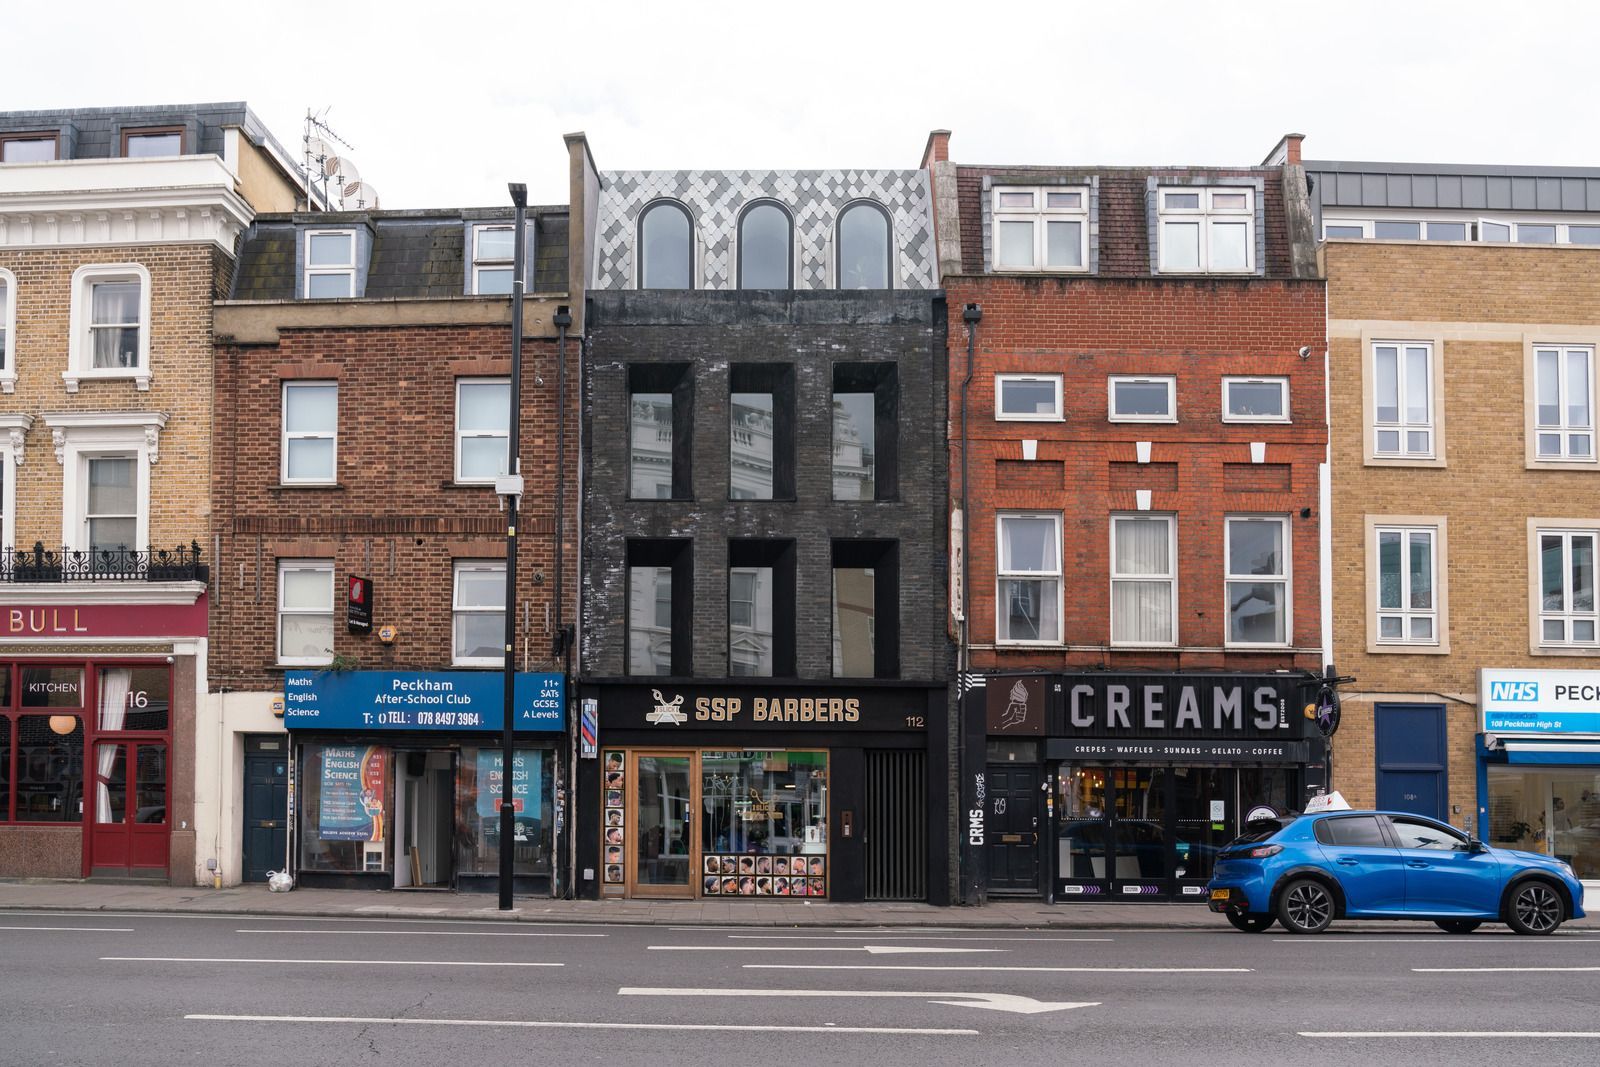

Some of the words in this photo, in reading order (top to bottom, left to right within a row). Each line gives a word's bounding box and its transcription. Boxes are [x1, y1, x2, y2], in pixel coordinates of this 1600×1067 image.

[9, 609, 88, 632] BULL
[288, 678, 313, 686] Maths
[392, 679, 453, 691] Peckham
[29, 683, 77, 693] KITCHEN
[540, 689, 559, 698] SATs
[1491, 682, 1537, 700] NHS
[127, 691, 148, 708] 16
[288, 693, 318, 703] English
[374, 694, 443, 704] After-School
[446, 694, 471, 704] Club
[533, 700, 559, 708] GCSEs
[695, 697, 742, 721] SSP
[753, 697, 860, 722] BARBERS
[1071, 684, 1277, 729] CREAMS
[288, 708, 320, 716] Science
[531, 710, 559, 719] Levels
[363, 713, 373, 724] T:
[417, 712, 433, 725] 078
[435, 712, 456, 725] 8497
[457, 712, 479, 726] 3964
[906, 716, 924, 728] 112
[1504, 720, 1535, 728] Peckham
[1536, 721, 1552, 729] High
[325, 747, 356, 758] MATHS
[1164, 746, 1201, 754] SUNDAES
[325, 758, 360, 769] ENGLISH
[324, 769, 358, 780] SCIENCE
[969, 809, 984, 846] CRMS
